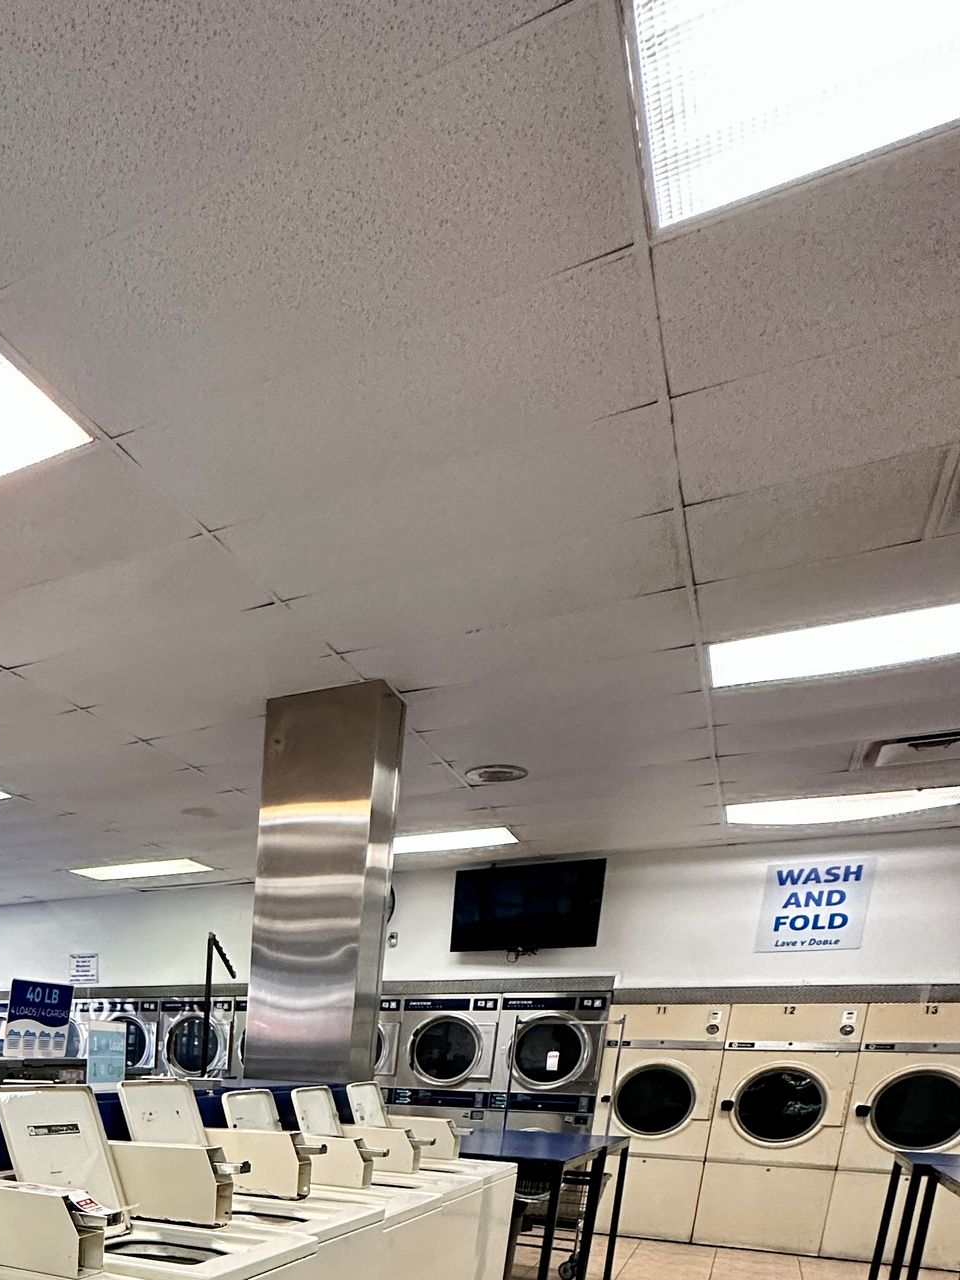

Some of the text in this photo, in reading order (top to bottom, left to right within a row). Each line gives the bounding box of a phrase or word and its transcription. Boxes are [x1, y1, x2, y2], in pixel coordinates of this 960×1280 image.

[776, 864, 864, 886] WASH
[782, 889, 847, 909] AND
[773, 912, 849, 932] FOLD
[26, 986, 60, 1004] 40 LB
[10, 1006, 16, 1014] 4
[16, 1006, 37, 1016] LOADS
[46, 1009, 69, 1018] CARGAS
[657, 1006, 667, 1014] 11
[783, 1006, 796, 1015] 12
[925, 1005, 938, 1015] 13
